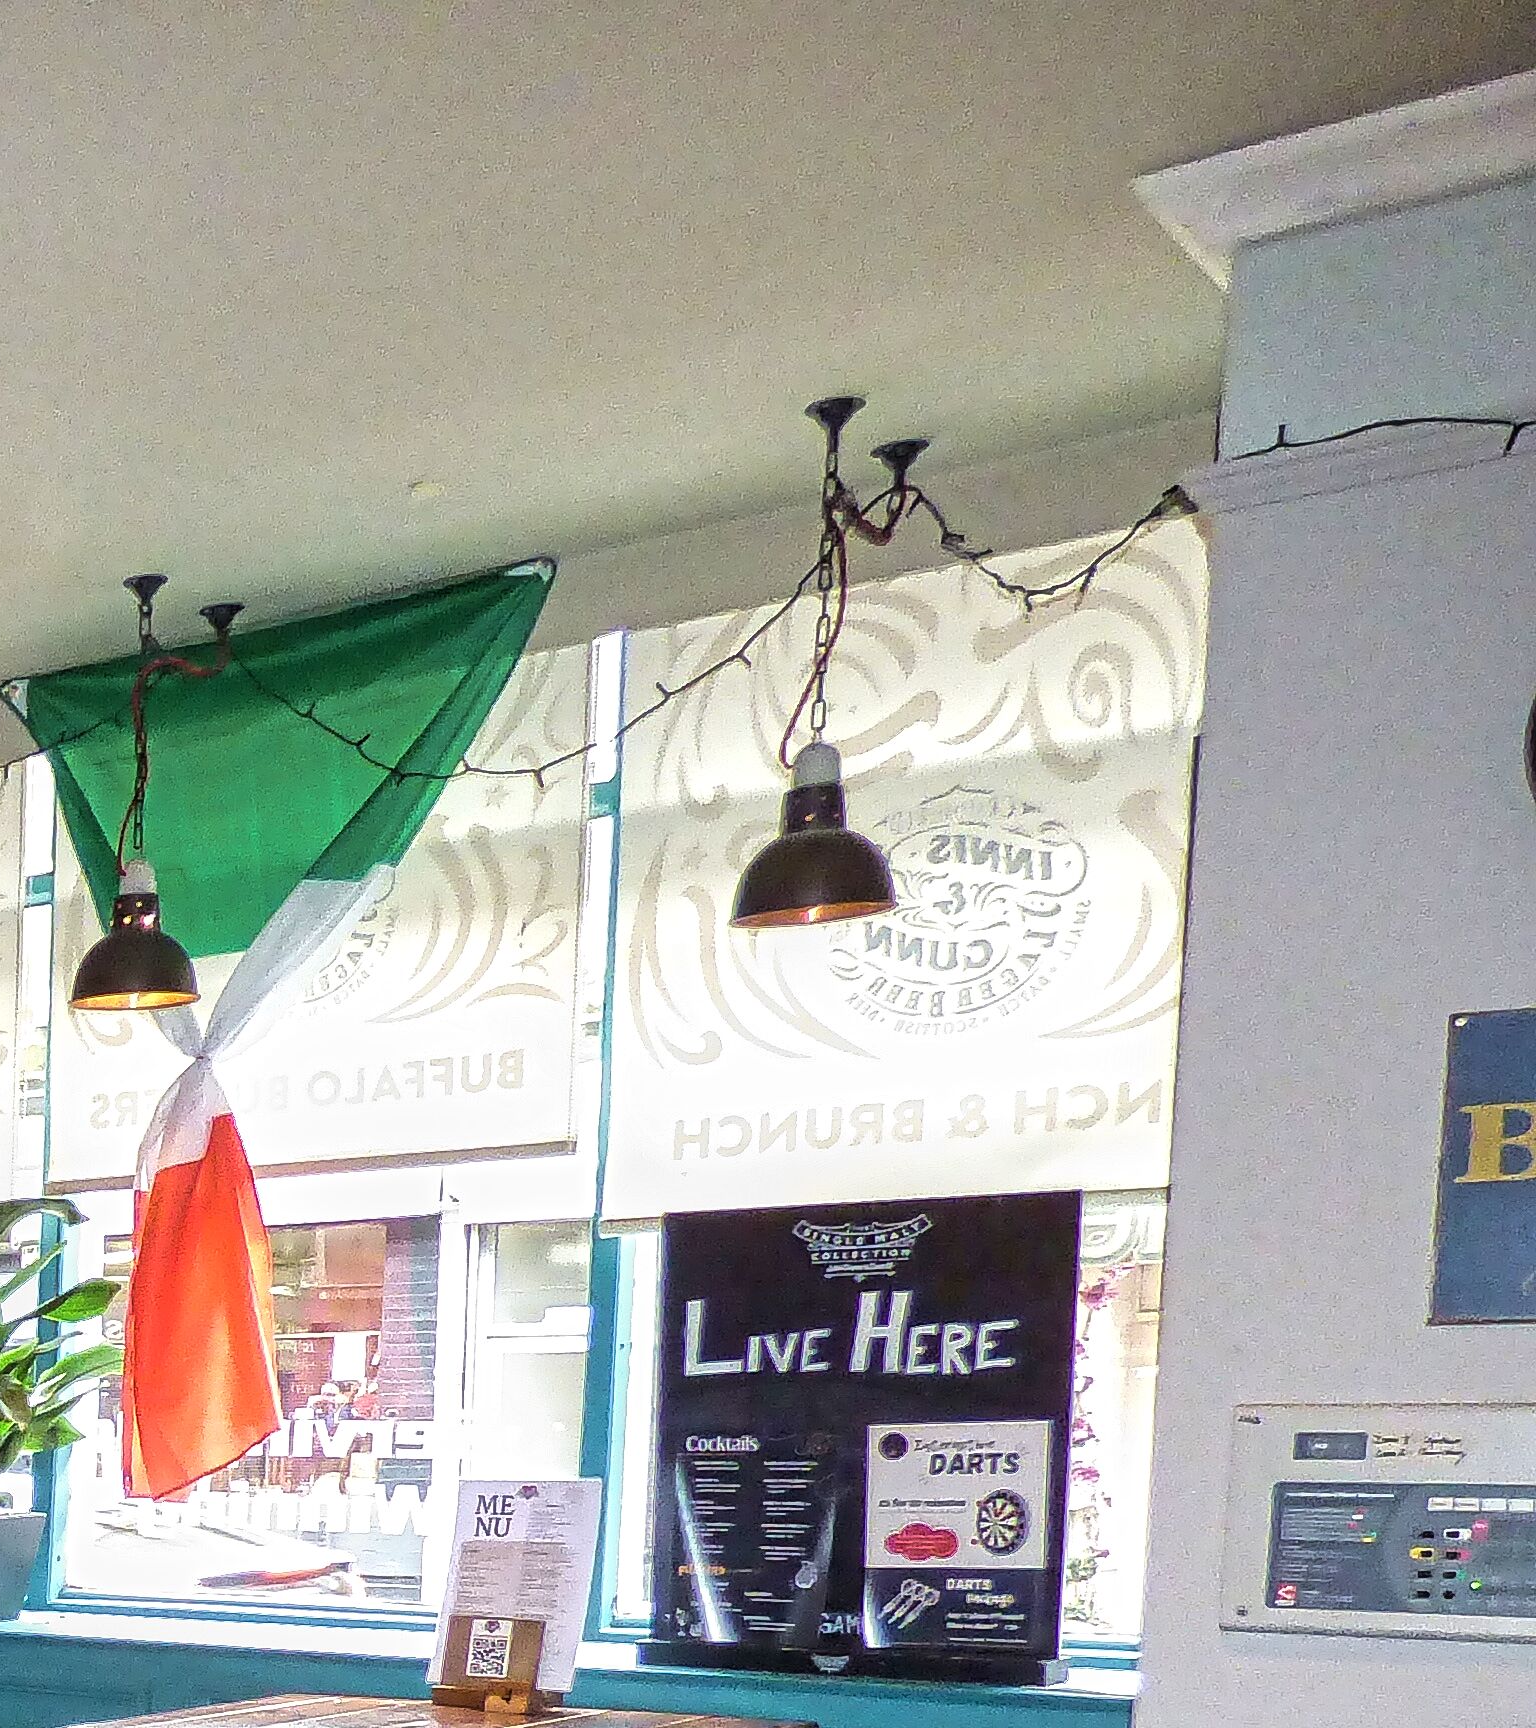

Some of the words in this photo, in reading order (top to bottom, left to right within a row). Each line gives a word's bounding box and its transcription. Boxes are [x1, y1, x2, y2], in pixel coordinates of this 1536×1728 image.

[802, 1227, 865, 1246] SINGLE
[810, 1248, 912, 1262] COLLECTION
[686, 1434, 761, 1453] Cocktails
[928, 1452, 1021, 1476] DARTS
[474, 1494, 516, 1516] ME
[473, 1517, 514, 1538] NU
[945, 1578, 993, 1591] DARTS
